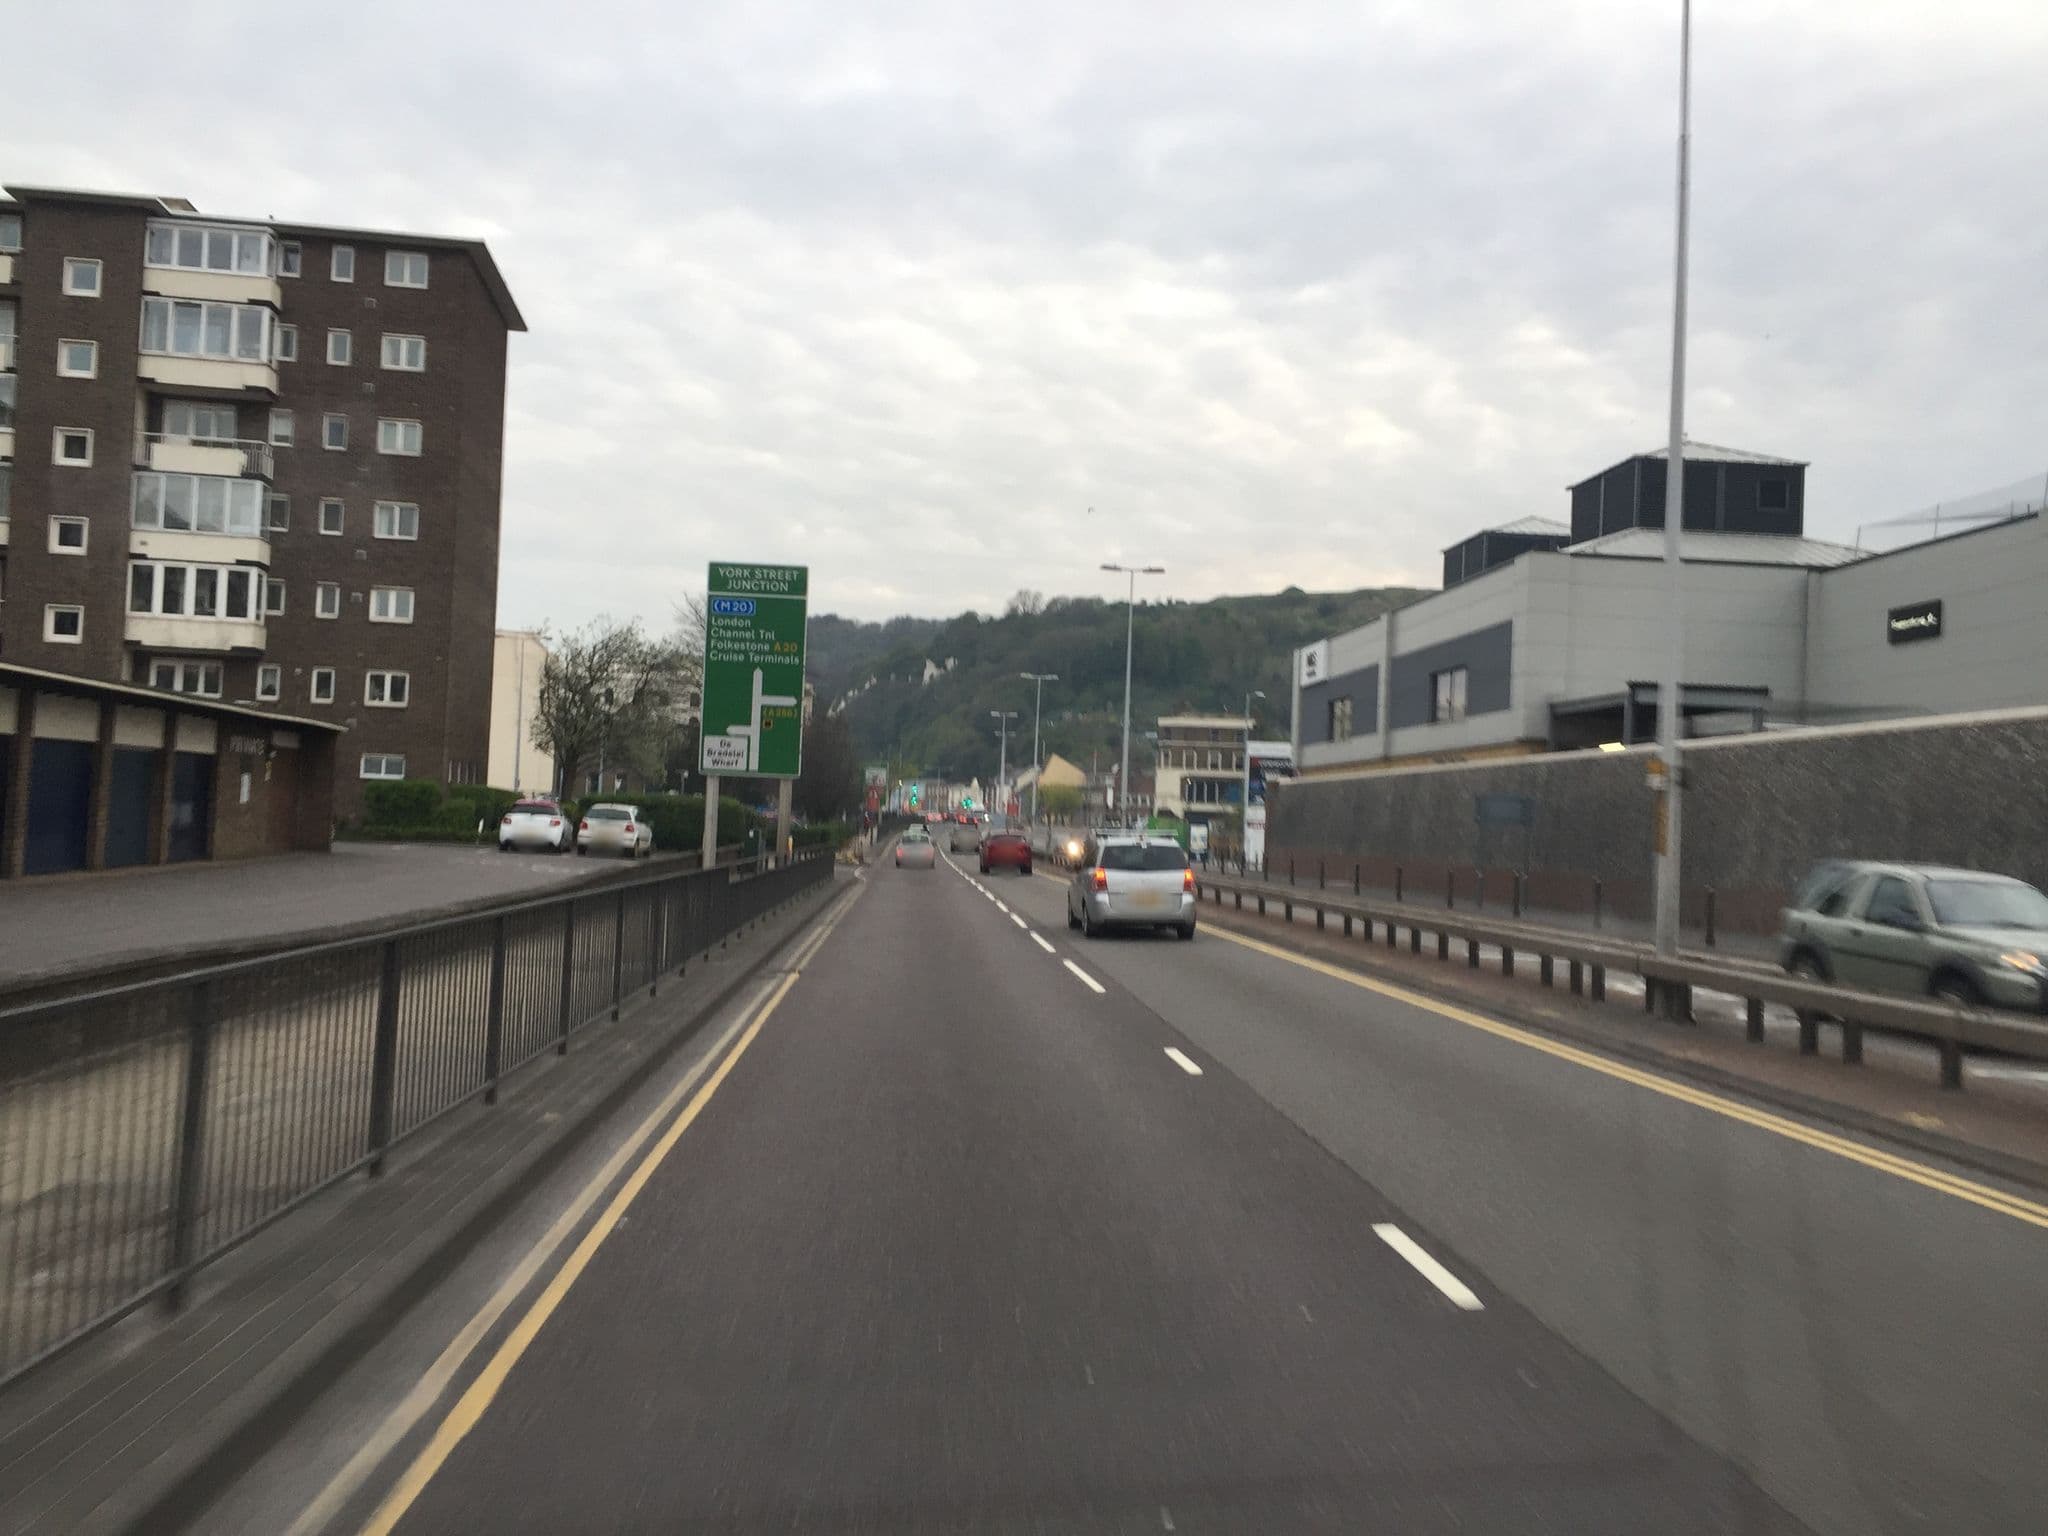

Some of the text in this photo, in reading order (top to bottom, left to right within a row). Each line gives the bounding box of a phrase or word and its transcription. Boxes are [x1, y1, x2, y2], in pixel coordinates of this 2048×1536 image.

[719, 567, 800, 581] YORK STREET
[727, 580, 789, 592] JUNCTION
[711, 616, 751, 628] London
[711, 627, 755, 640] Channel
[711, 639, 770, 652] Folkestone
[710, 650, 800, 665] Cruise Terminals
